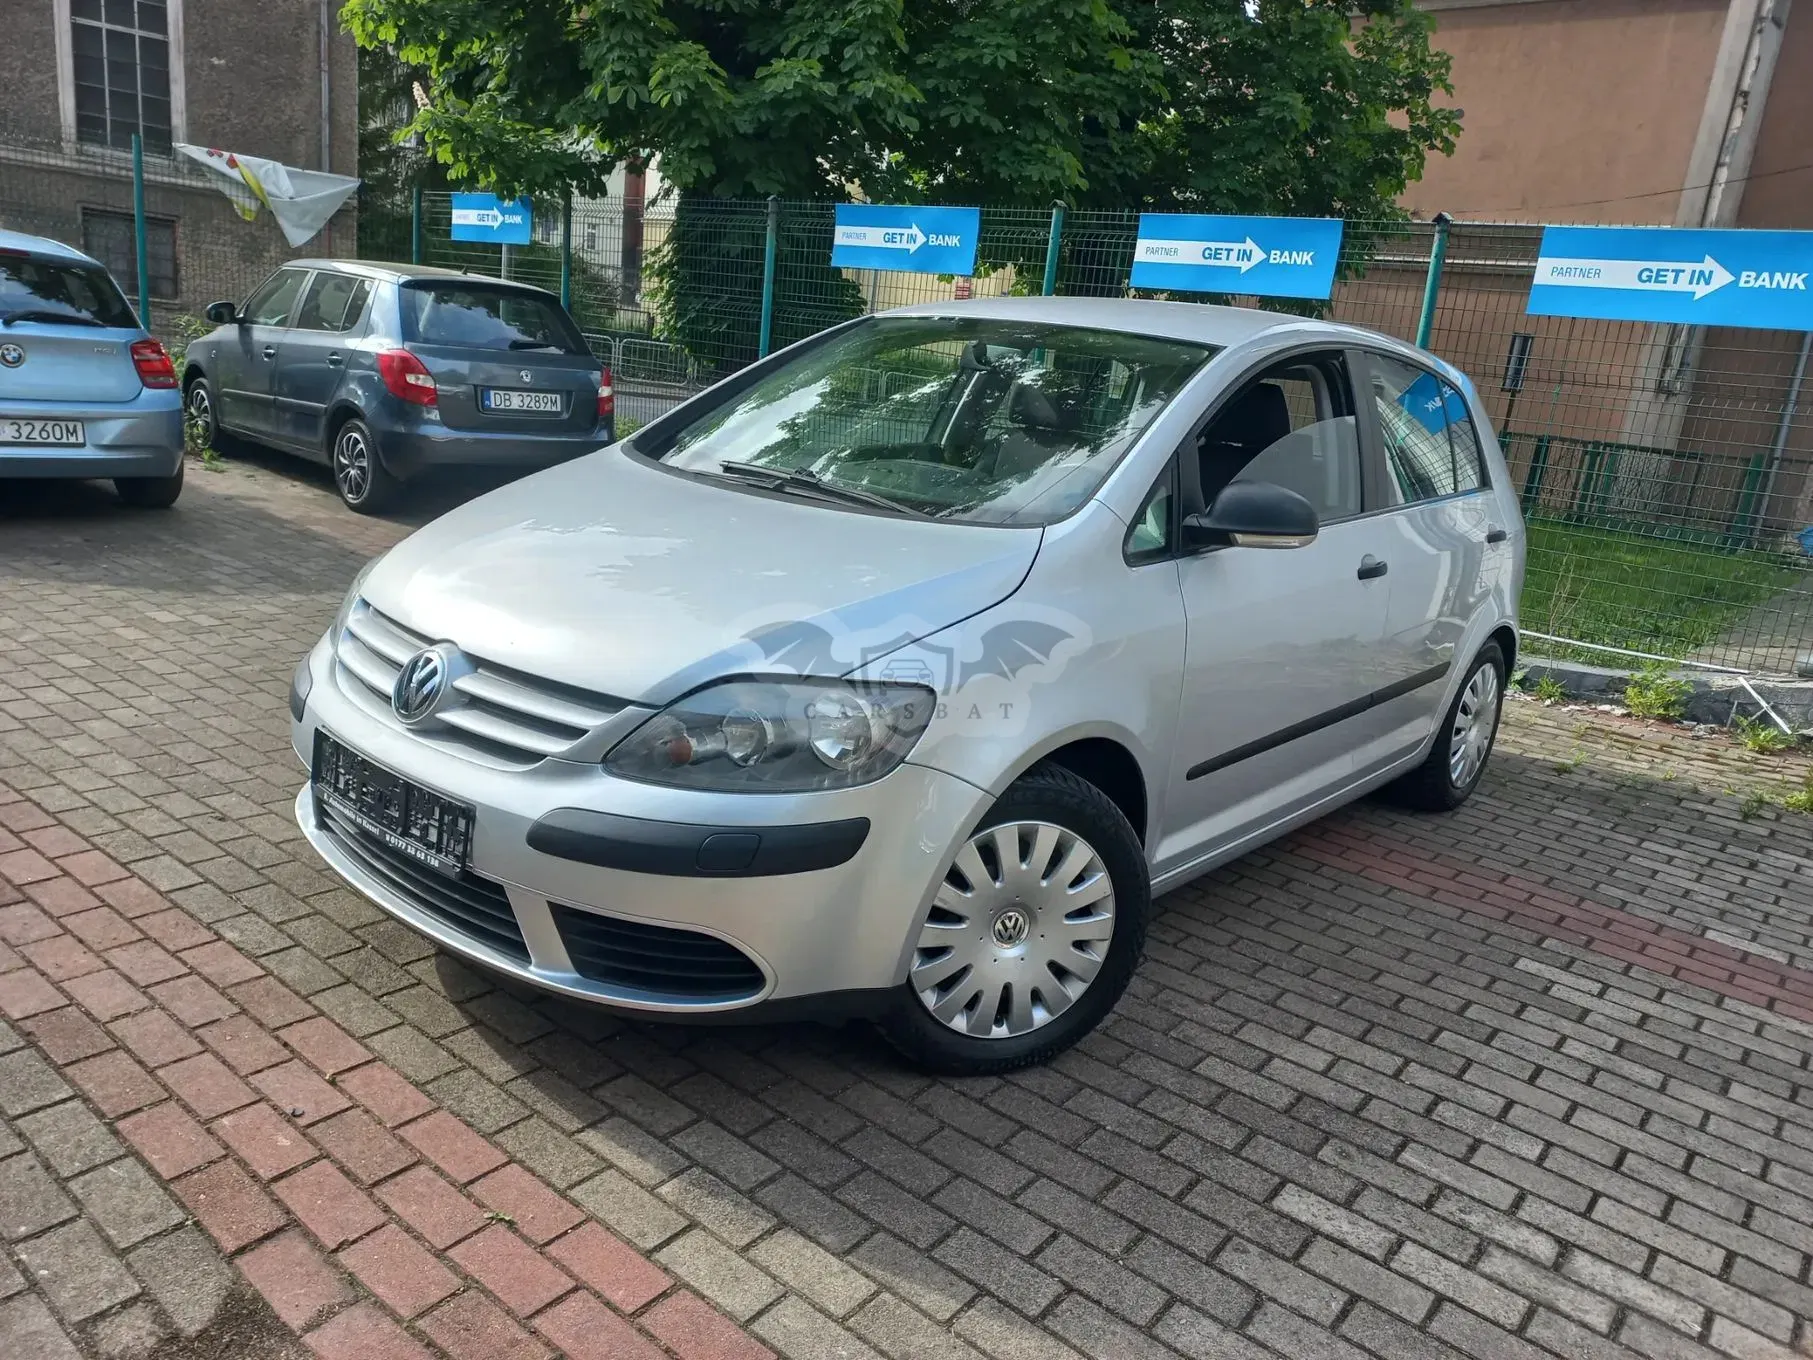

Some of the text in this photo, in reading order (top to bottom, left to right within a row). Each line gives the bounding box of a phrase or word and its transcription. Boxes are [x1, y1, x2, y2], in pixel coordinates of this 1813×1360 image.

[477, 213, 490, 222] GET
[504, 214, 523, 225] BANK
[841, 232, 960, 247] PARTNER GET IN BANK
[1145, 247, 1315, 265] PARTNER GET IN BANK
[1550, 266, 1809, 290] PARTNER GET IN BANK
[493, 392, 558, 410] DB 3289M
[9, 421, 79, 442] 3260M
